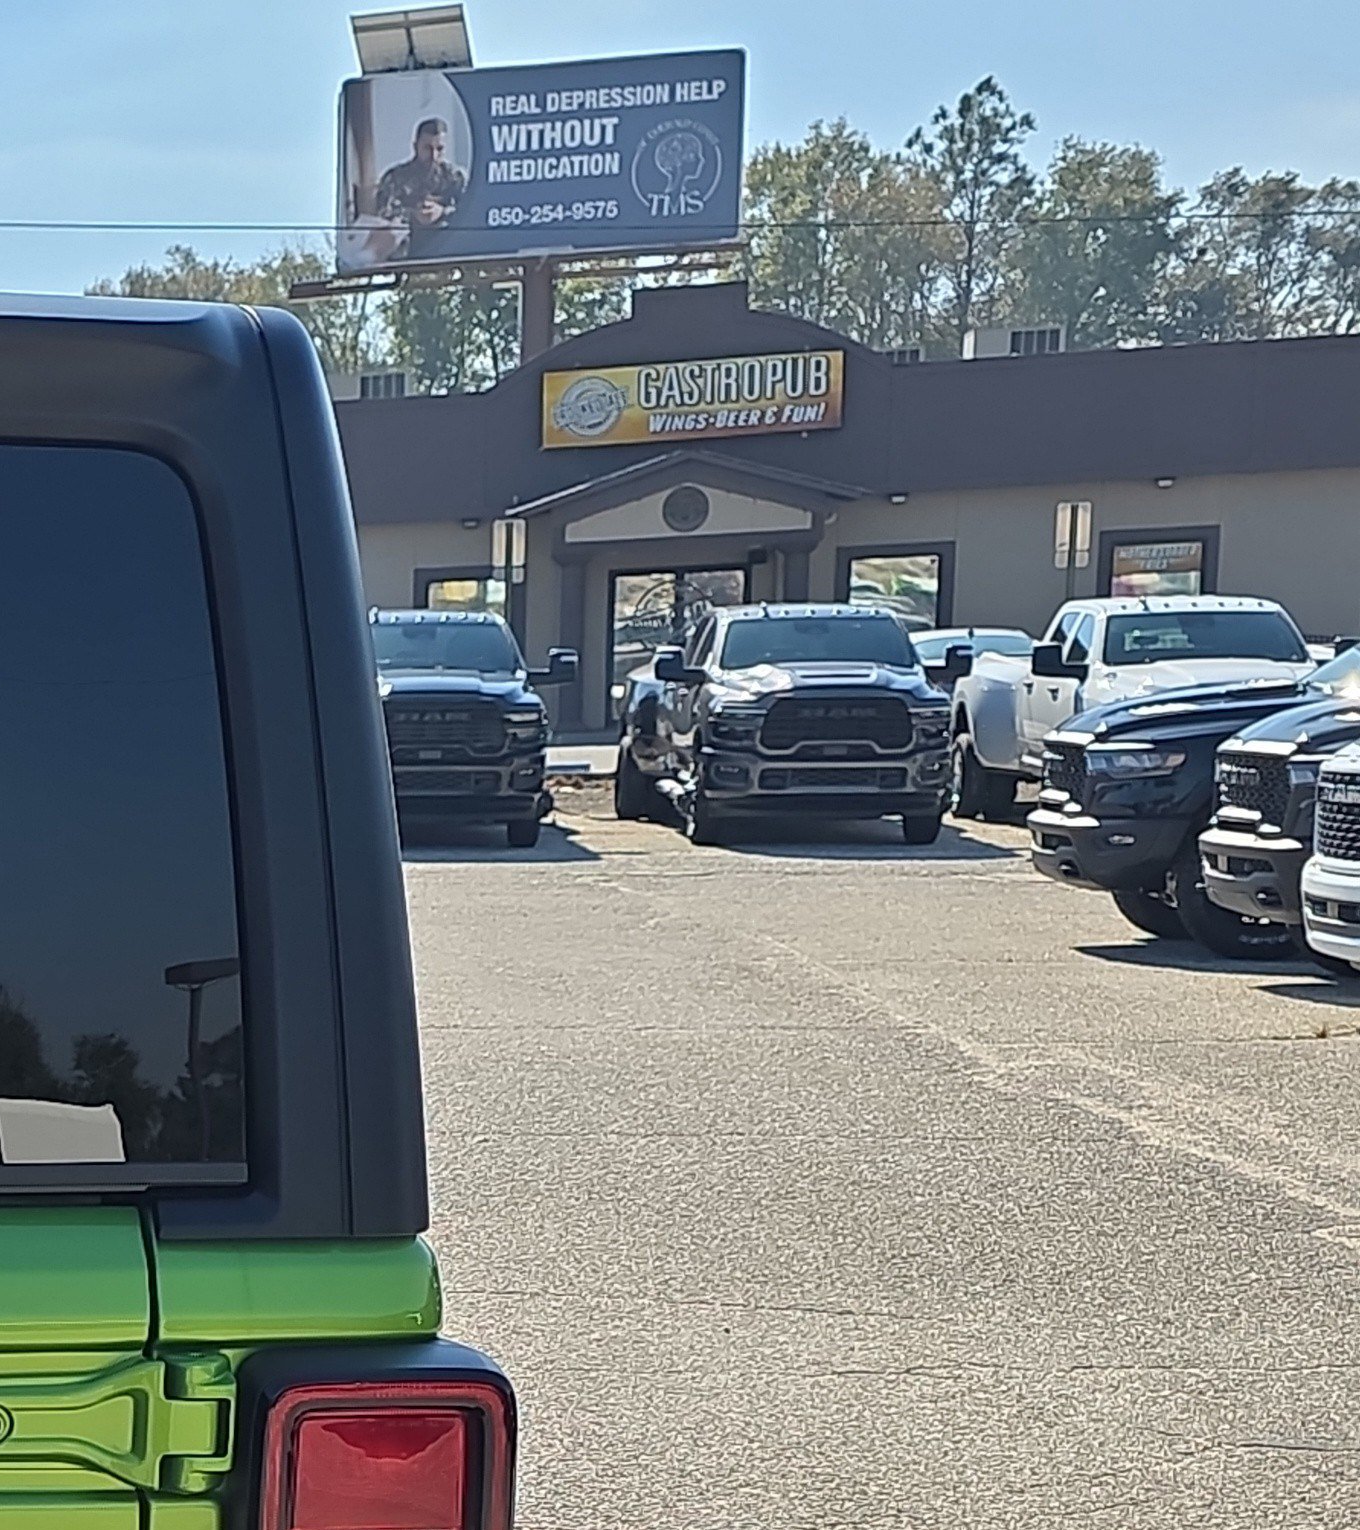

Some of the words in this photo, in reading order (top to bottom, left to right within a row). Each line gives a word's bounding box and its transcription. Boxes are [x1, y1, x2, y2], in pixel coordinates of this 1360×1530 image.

[491, 97, 541, 116] REAL
[546, 83, 670, 112] DEPRESSION
[675, 79, 726, 102] HELP
[491, 117, 619, 153] WITHOUT
[488, 152, 620, 183] MEDICATION
[647, 190, 704, 216] TMS
[639, 356, 828, 409] GASTROPUB
[781, 402, 826, 423] FUN!
